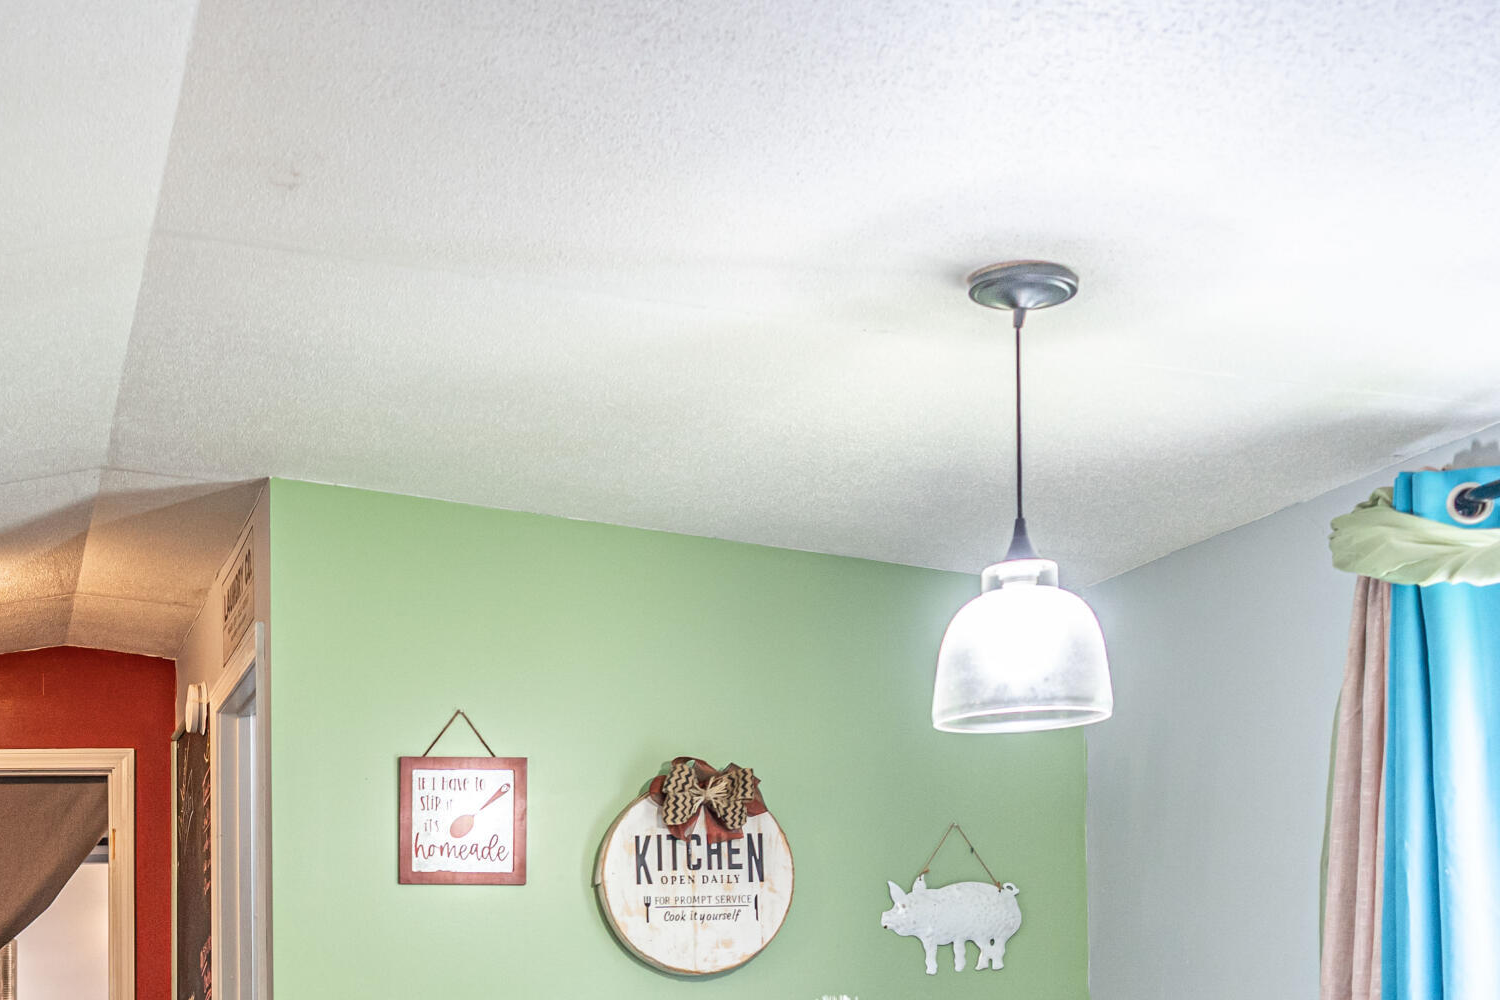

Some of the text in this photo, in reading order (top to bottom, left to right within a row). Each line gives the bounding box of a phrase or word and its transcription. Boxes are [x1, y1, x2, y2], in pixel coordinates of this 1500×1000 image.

[634, 832, 765, 885] KITCHEN
[660, 874, 741, 885] OPEN DAILY
[654, 894, 752, 905] FOR PROMPT SERVICE
[663, 909, 742, 924] Cook it yourself
